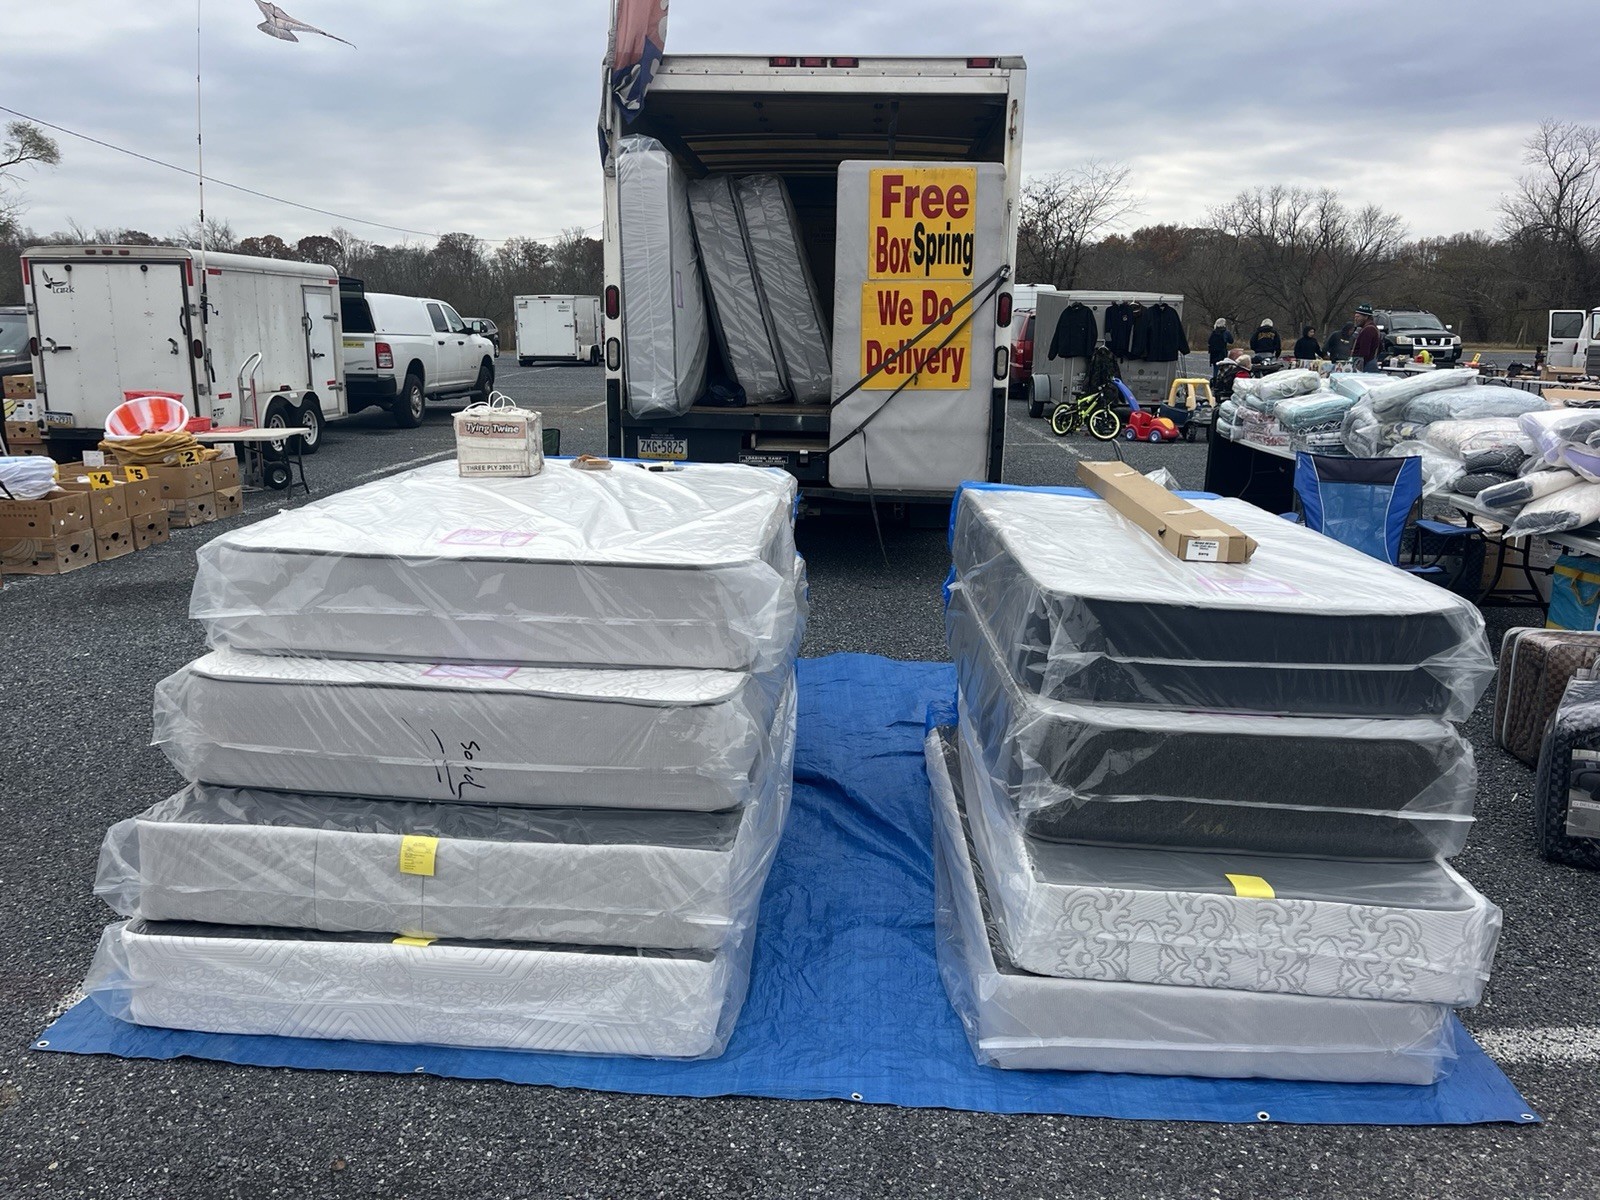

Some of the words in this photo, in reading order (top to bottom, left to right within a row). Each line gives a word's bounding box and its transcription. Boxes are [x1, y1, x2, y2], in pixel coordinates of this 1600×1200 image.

[882, 175, 969, 219] Free
[876, 226, 911, 274] Box
[914, 221, 974, 277] Spring
[877, 290, 914, 326] We
[922, 289, 954, 326] Do
[866, 338, 965, 383] Delivery
[465, 422, 491, 436] Tying
[491, 423, 520, 435] Twine
